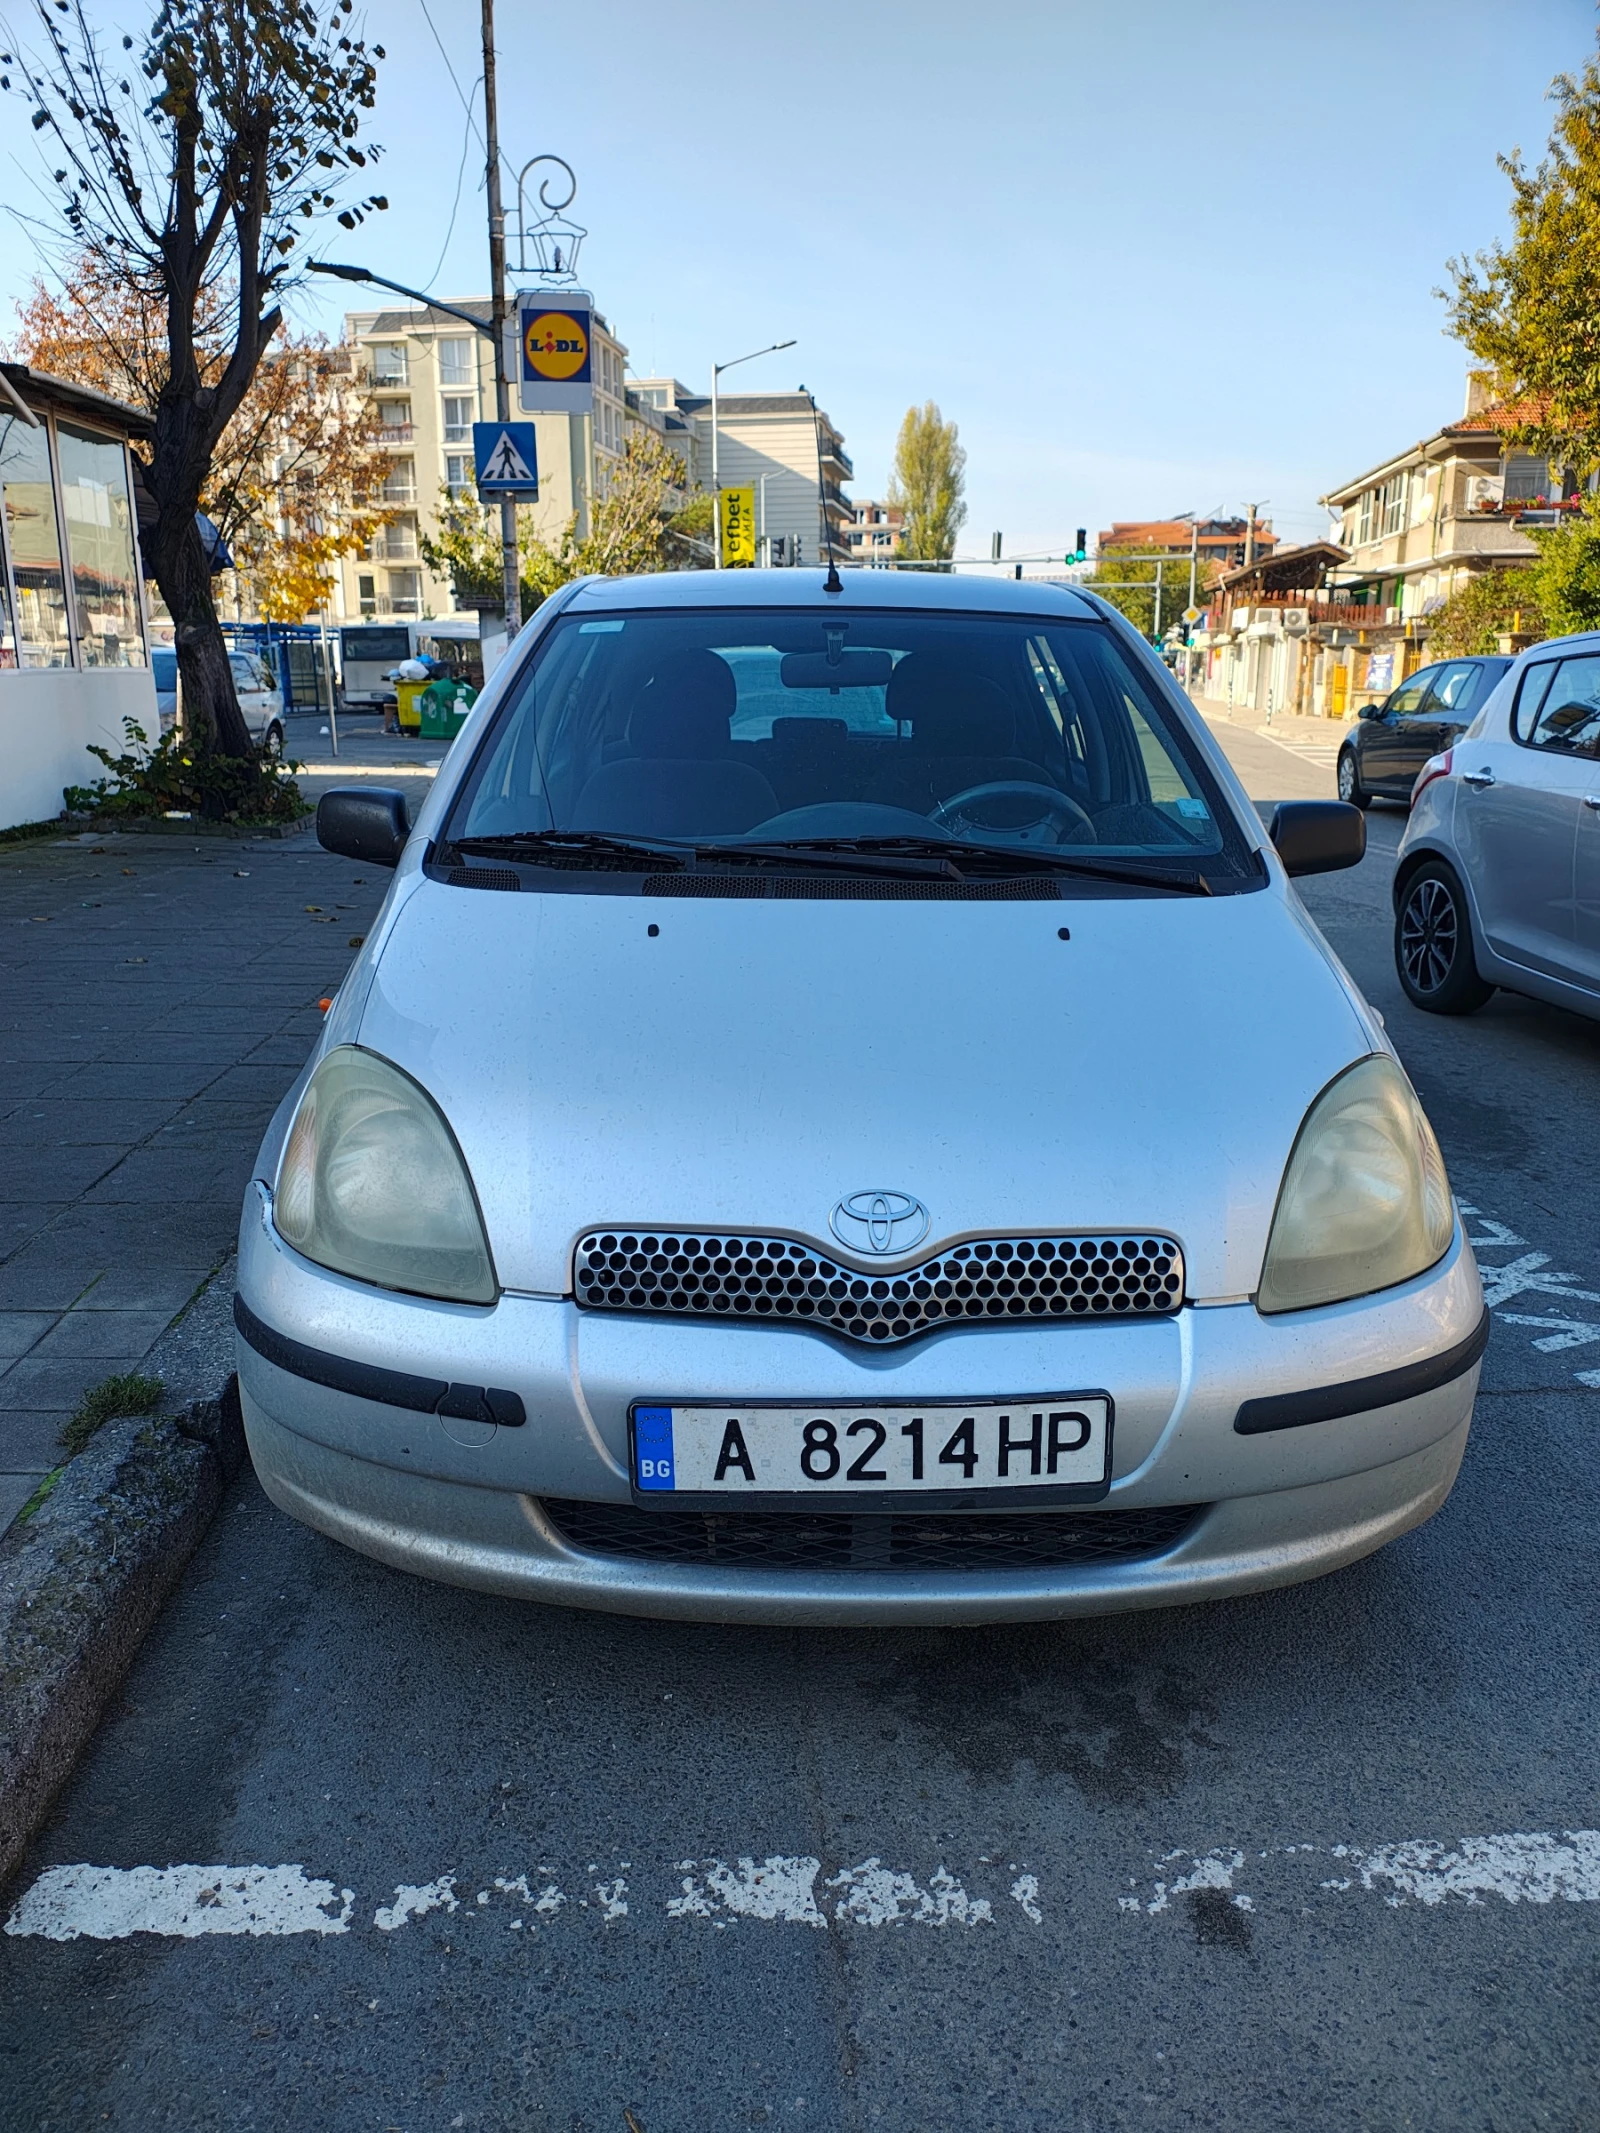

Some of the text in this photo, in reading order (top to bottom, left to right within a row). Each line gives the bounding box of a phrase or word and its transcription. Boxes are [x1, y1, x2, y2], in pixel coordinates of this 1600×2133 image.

[726, 493, 741, 553] efbet
[641, 1459, 671, 1478] BG
[713, 1418, 756, 1481] A
